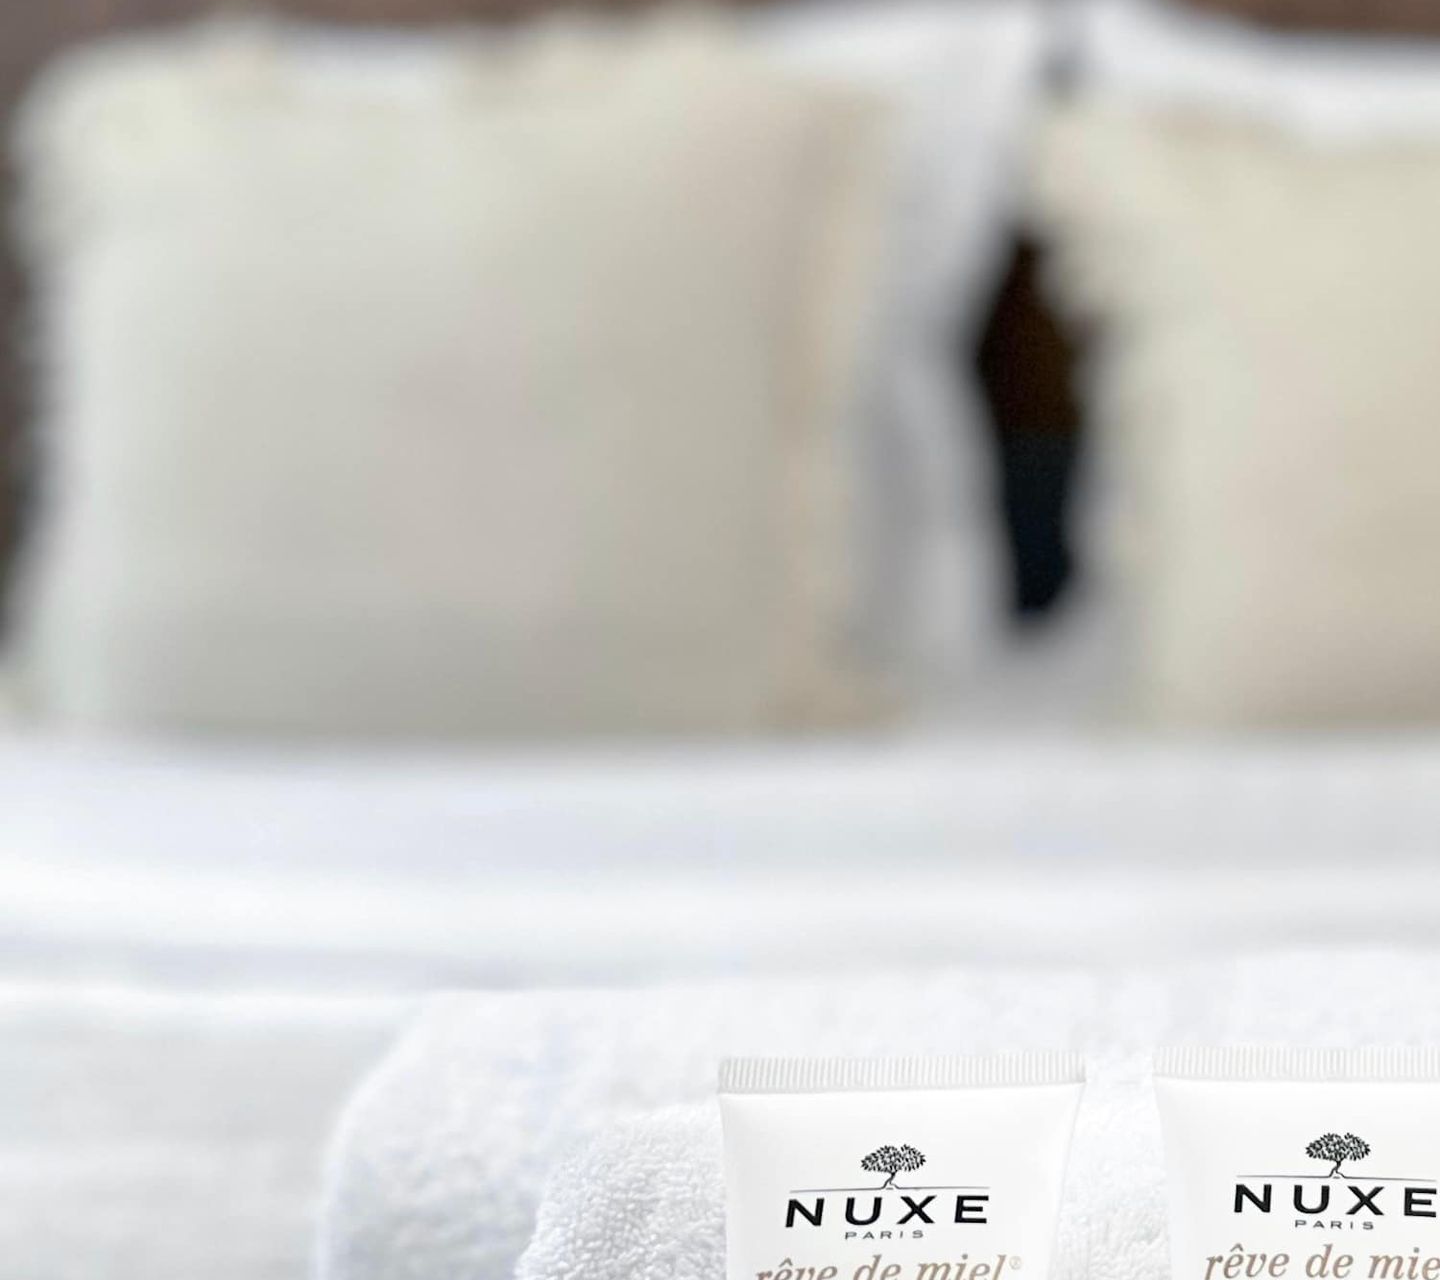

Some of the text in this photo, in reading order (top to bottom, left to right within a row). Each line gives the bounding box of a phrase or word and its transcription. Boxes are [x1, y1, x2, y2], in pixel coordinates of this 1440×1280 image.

[785, 1195, 989, 1228] NUXE
[1233, 1183, 1438, 1218] NUXE
[844, 1229, 924, 1241] PARIS
[1294, 1219, 1375, 1231] PARIS
[1304, 1243, 1354, 1280] de
